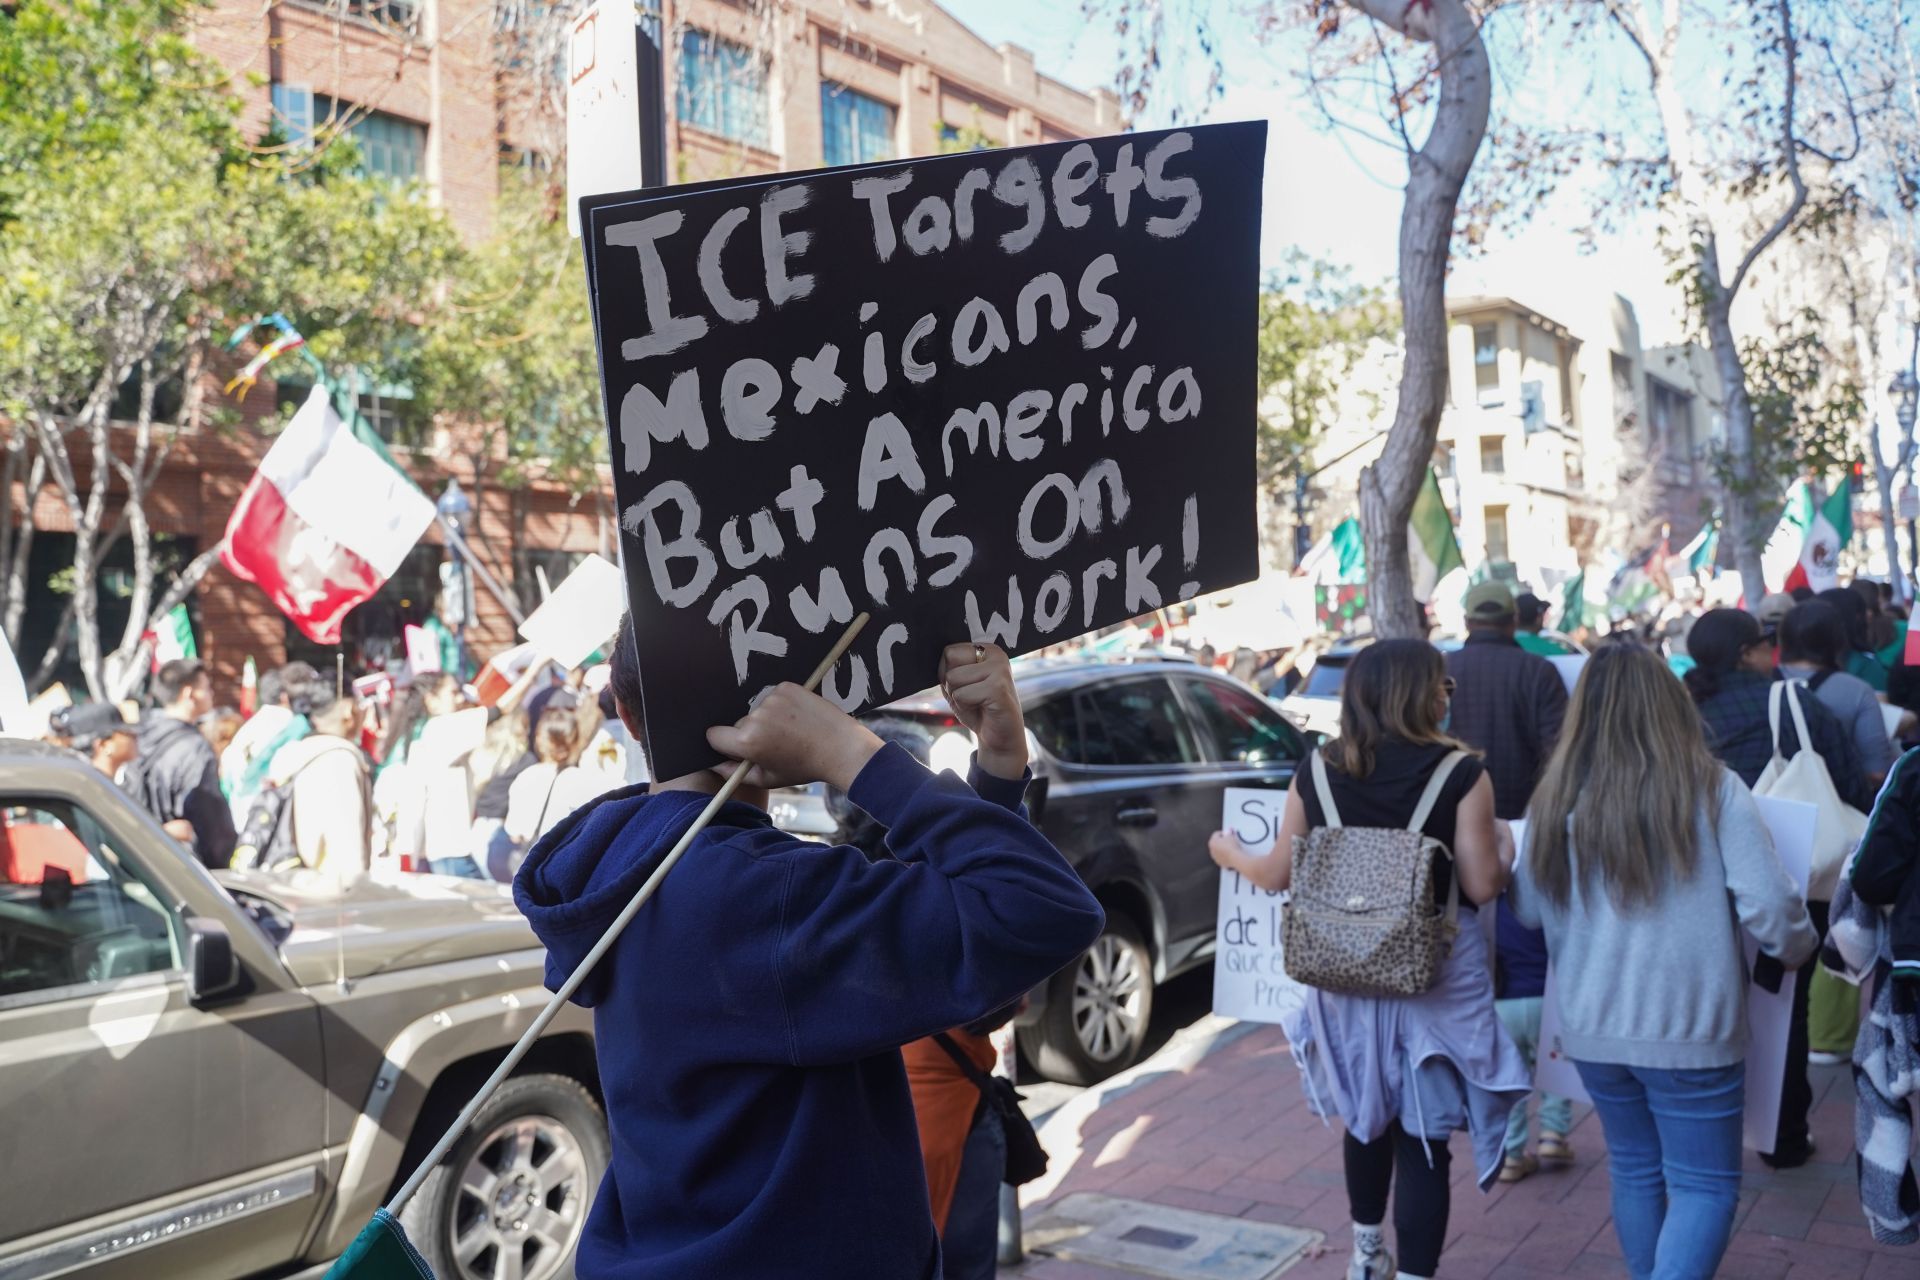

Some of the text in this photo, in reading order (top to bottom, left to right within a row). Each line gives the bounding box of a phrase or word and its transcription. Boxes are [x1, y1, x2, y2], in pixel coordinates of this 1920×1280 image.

[605, 131, 1202, 361] ICE Targets
[620, 253, 1138, 474] Mexicans,
[622, 364, 1202, 609] But America
[707, 458, 1131, 686] Runs On
[748, 622, 909, 714] ur
